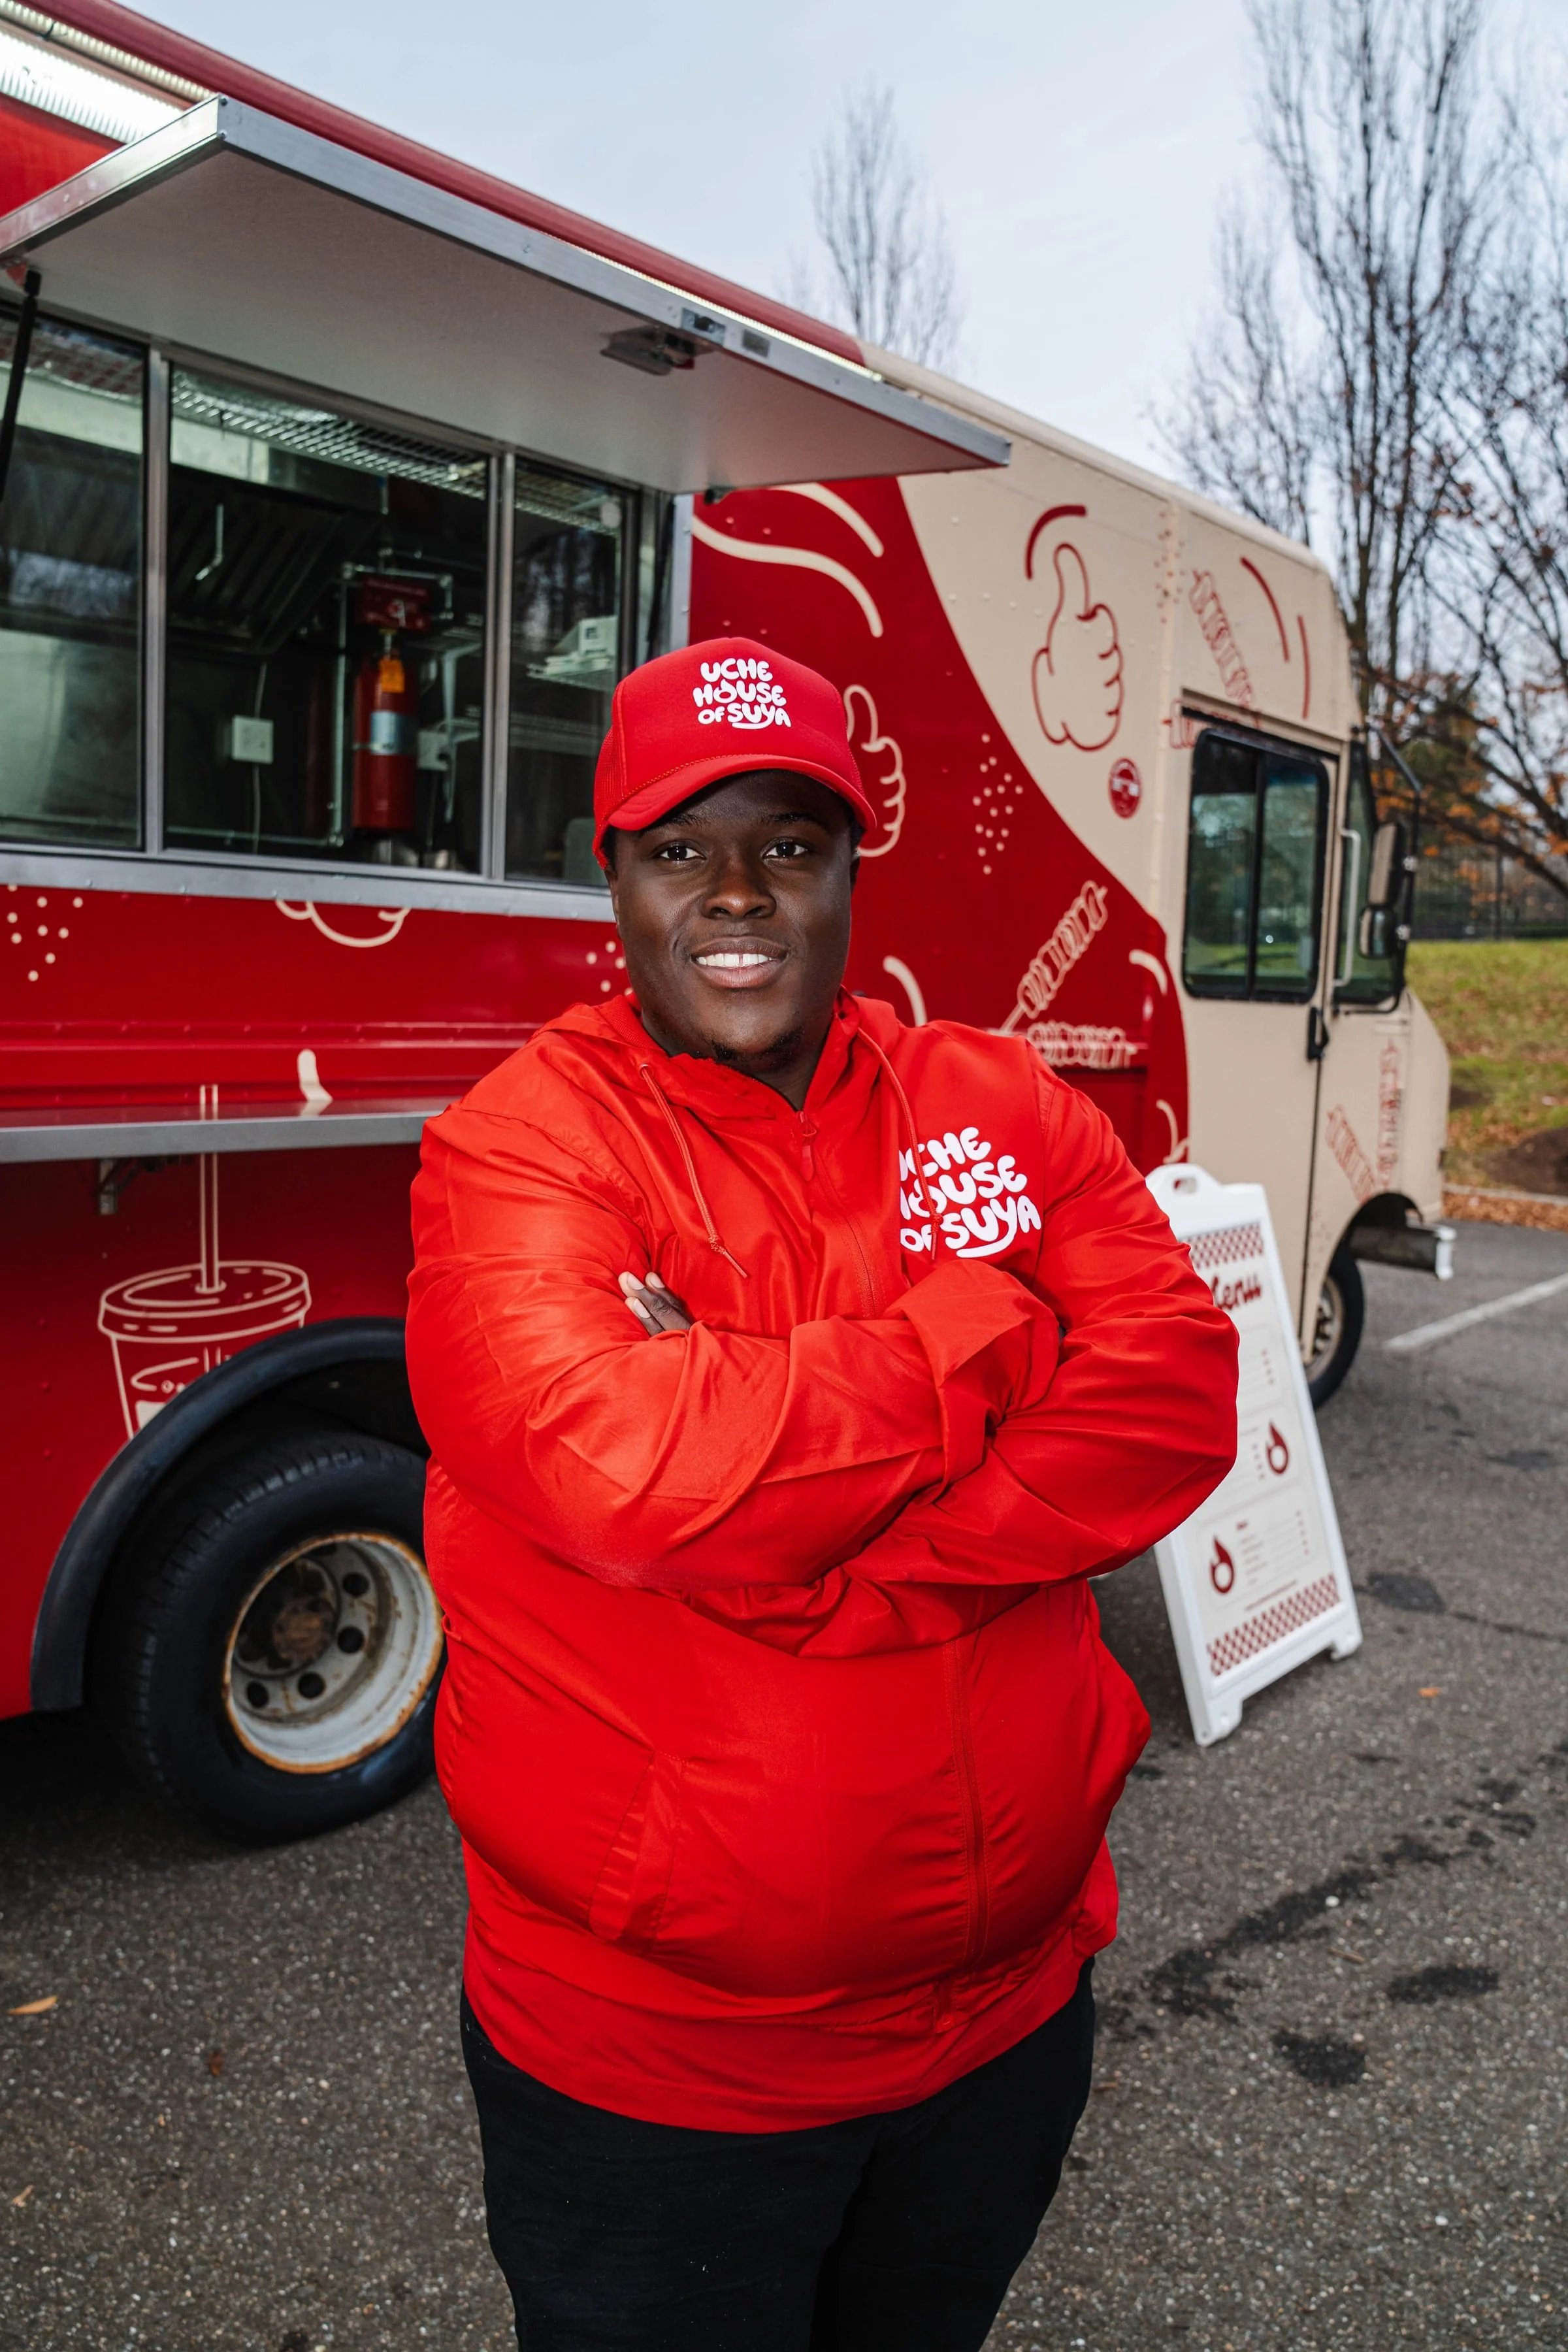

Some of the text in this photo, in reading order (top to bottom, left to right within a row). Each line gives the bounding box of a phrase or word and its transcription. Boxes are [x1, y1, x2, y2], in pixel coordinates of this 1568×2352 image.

[700, 658, 773, 682] UCHE
[693, 679, 787, 707] HOUSE
[698, 702, 792, 730] OF SUYA
[939, 1195, 1041, 1258] SUYA
